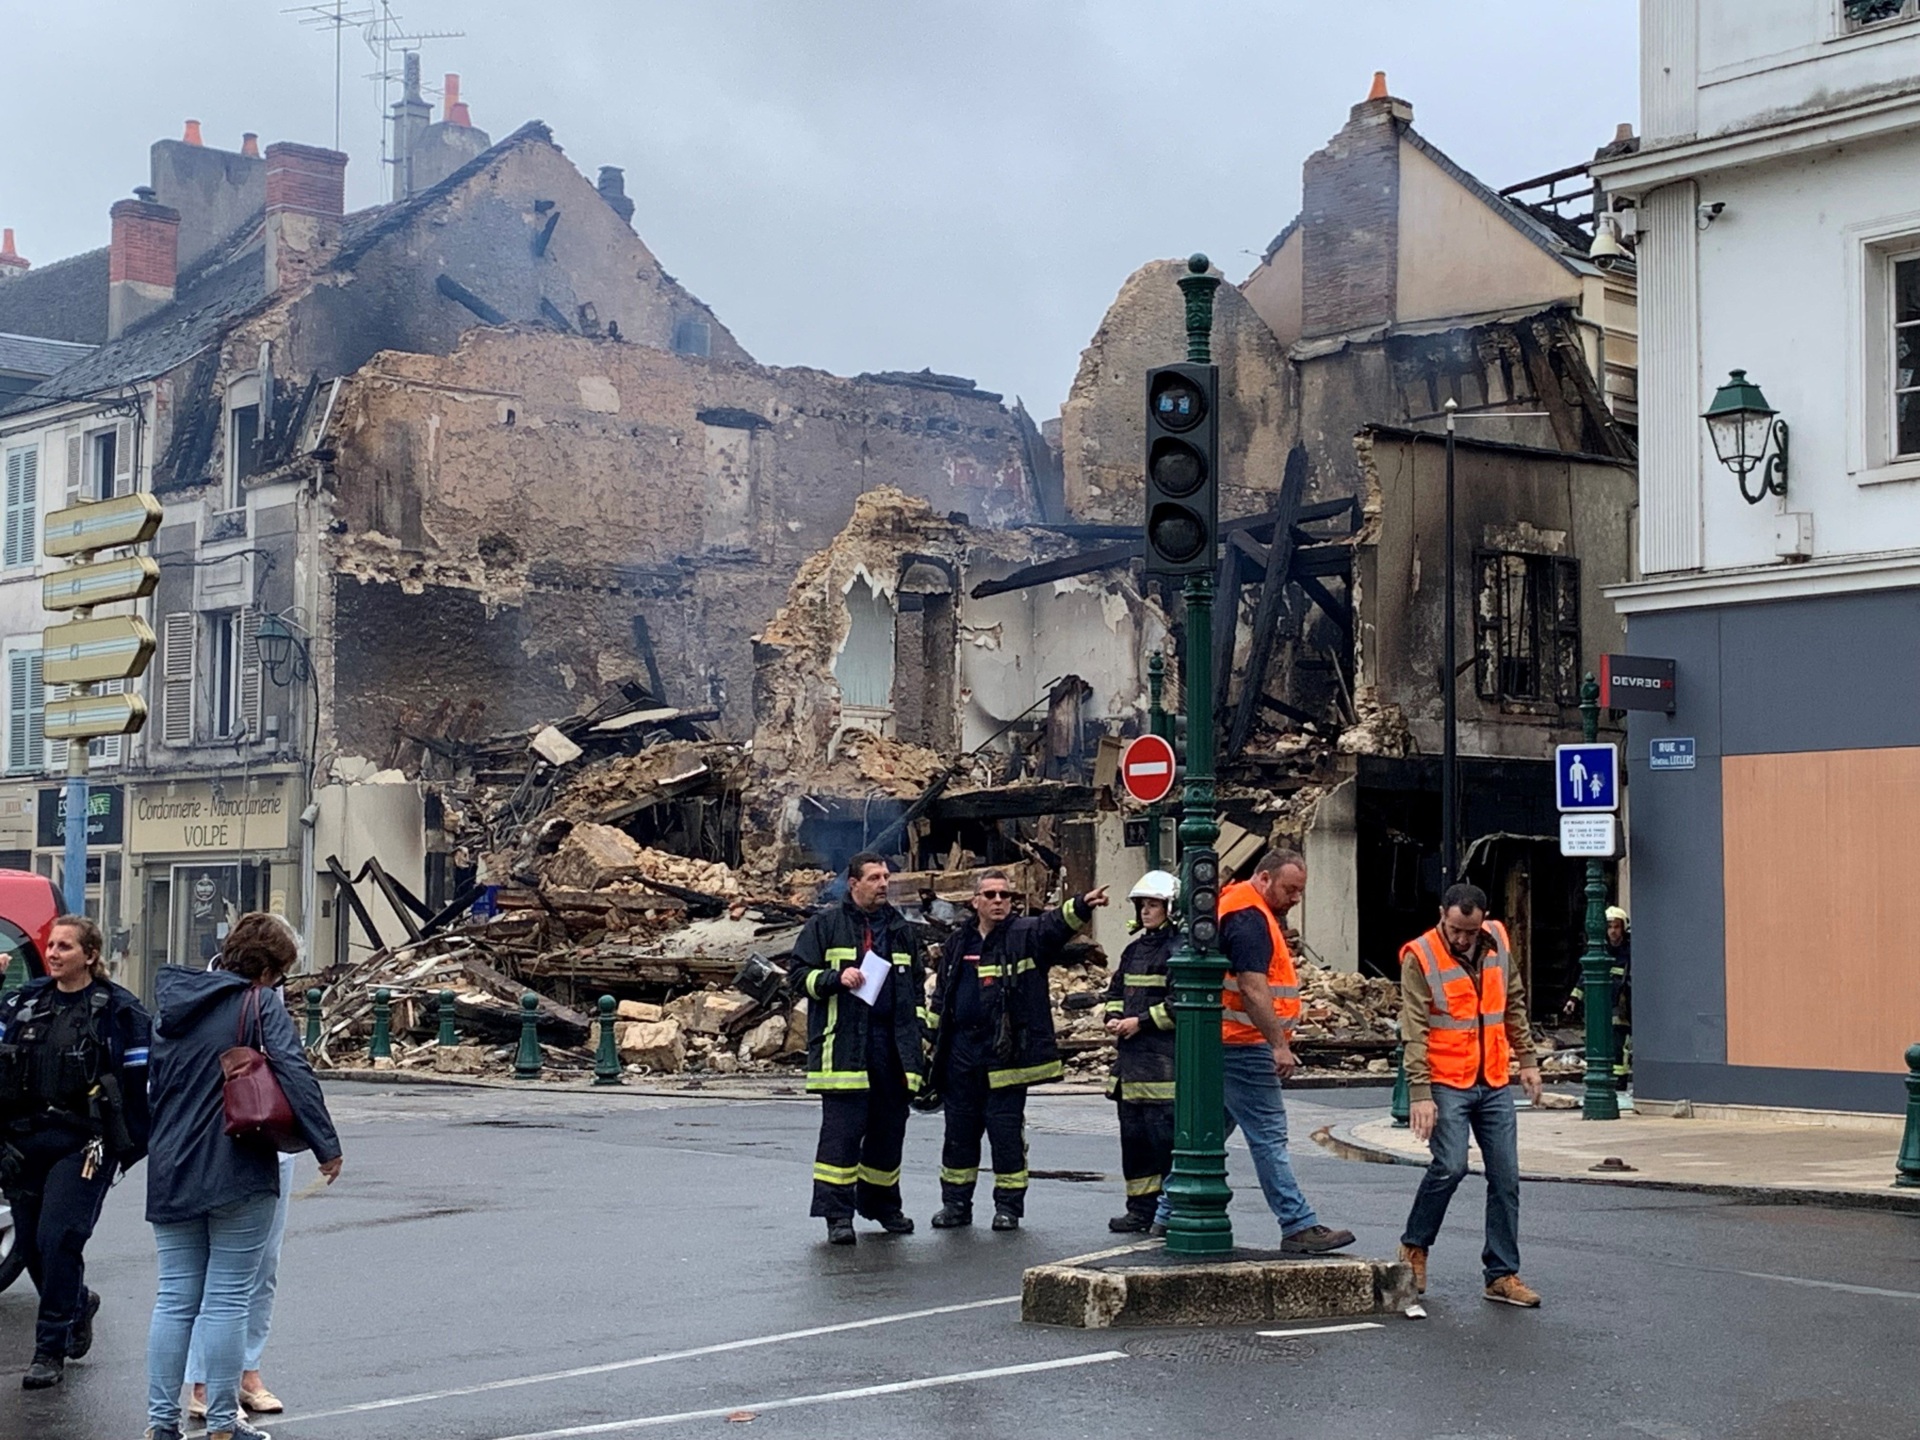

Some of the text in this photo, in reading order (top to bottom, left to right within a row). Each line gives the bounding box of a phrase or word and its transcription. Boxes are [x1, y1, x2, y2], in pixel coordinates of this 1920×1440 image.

[1658, 742, 1676, 752] RUE
[138, 796, 201, 821] Cordonnerie
[183, 818, 228, 847] VOLPÉ
